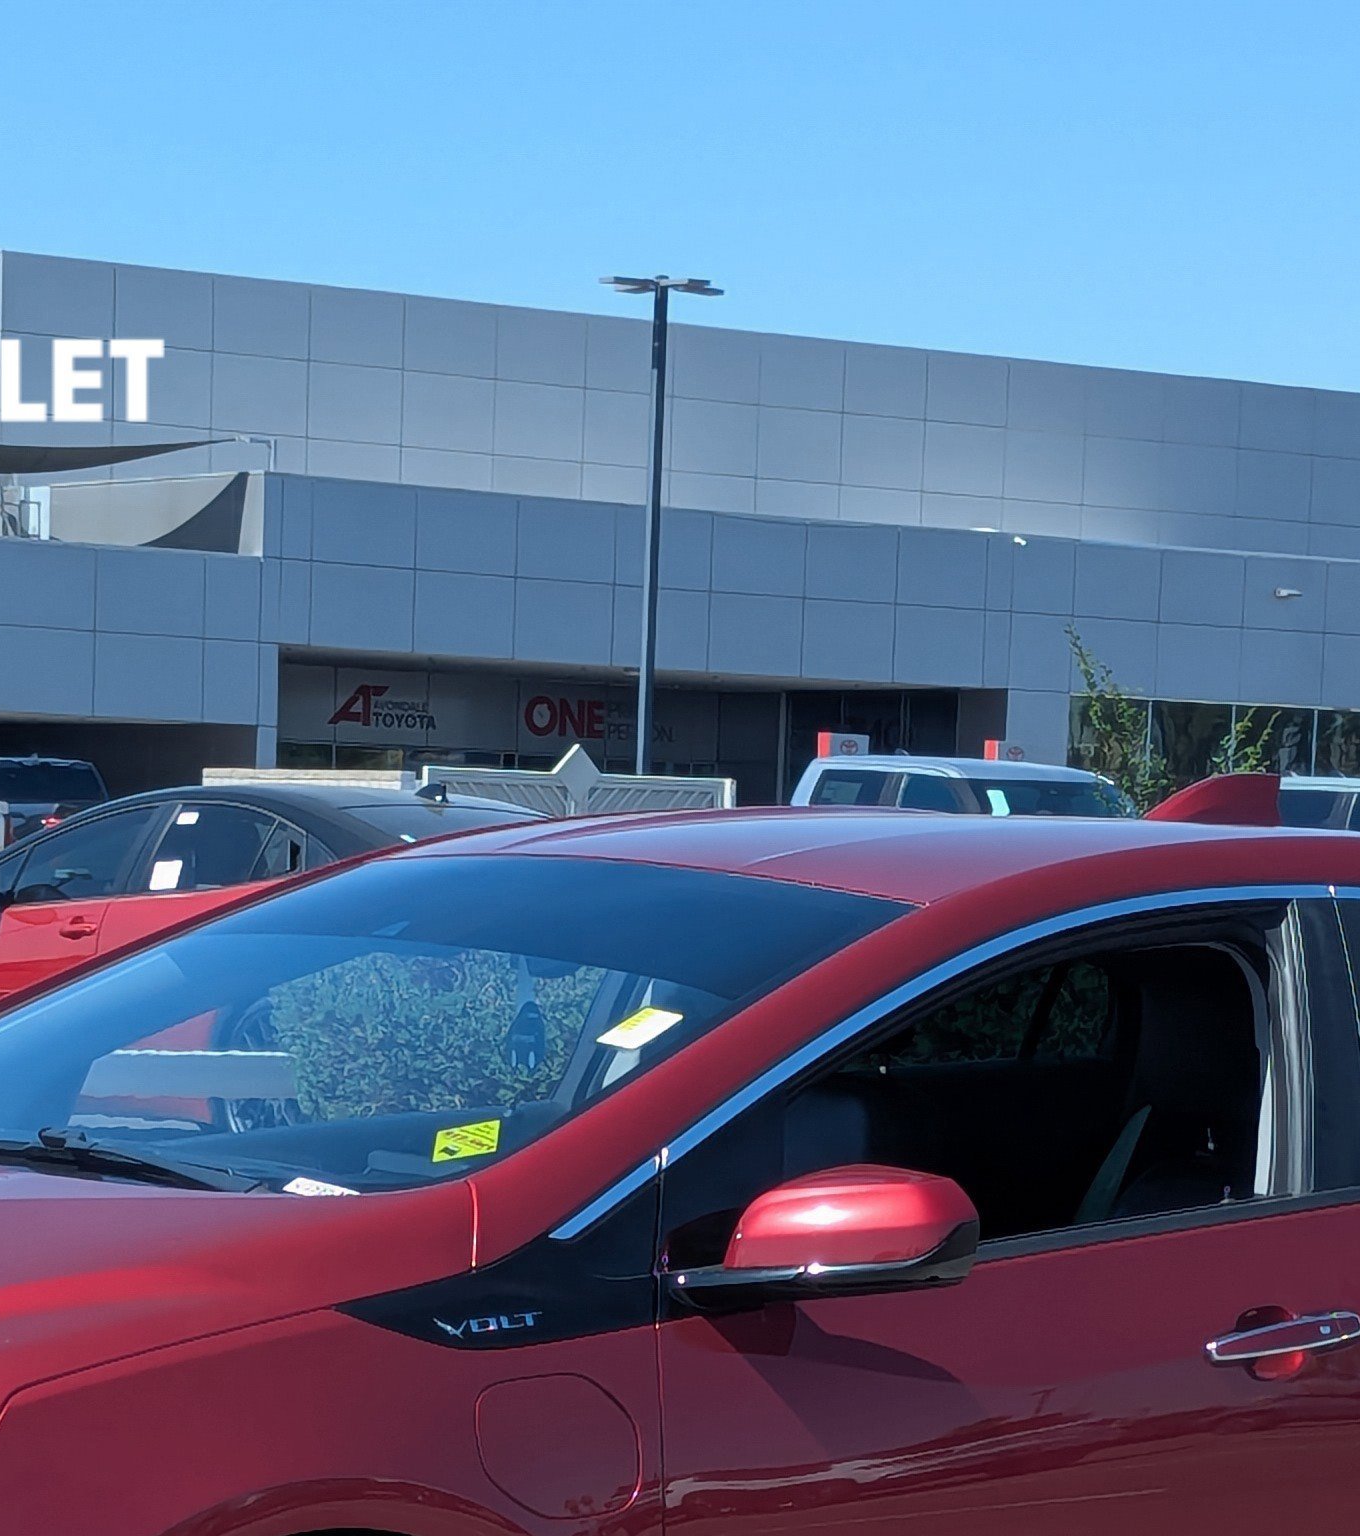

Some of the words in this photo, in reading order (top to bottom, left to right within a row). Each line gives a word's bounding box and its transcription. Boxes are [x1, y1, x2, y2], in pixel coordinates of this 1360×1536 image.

[373, 711, 437, 731] TOYOTA
[524, 695, 605, 739] ONE
[433, 1311, 543, 1340] VOLT
